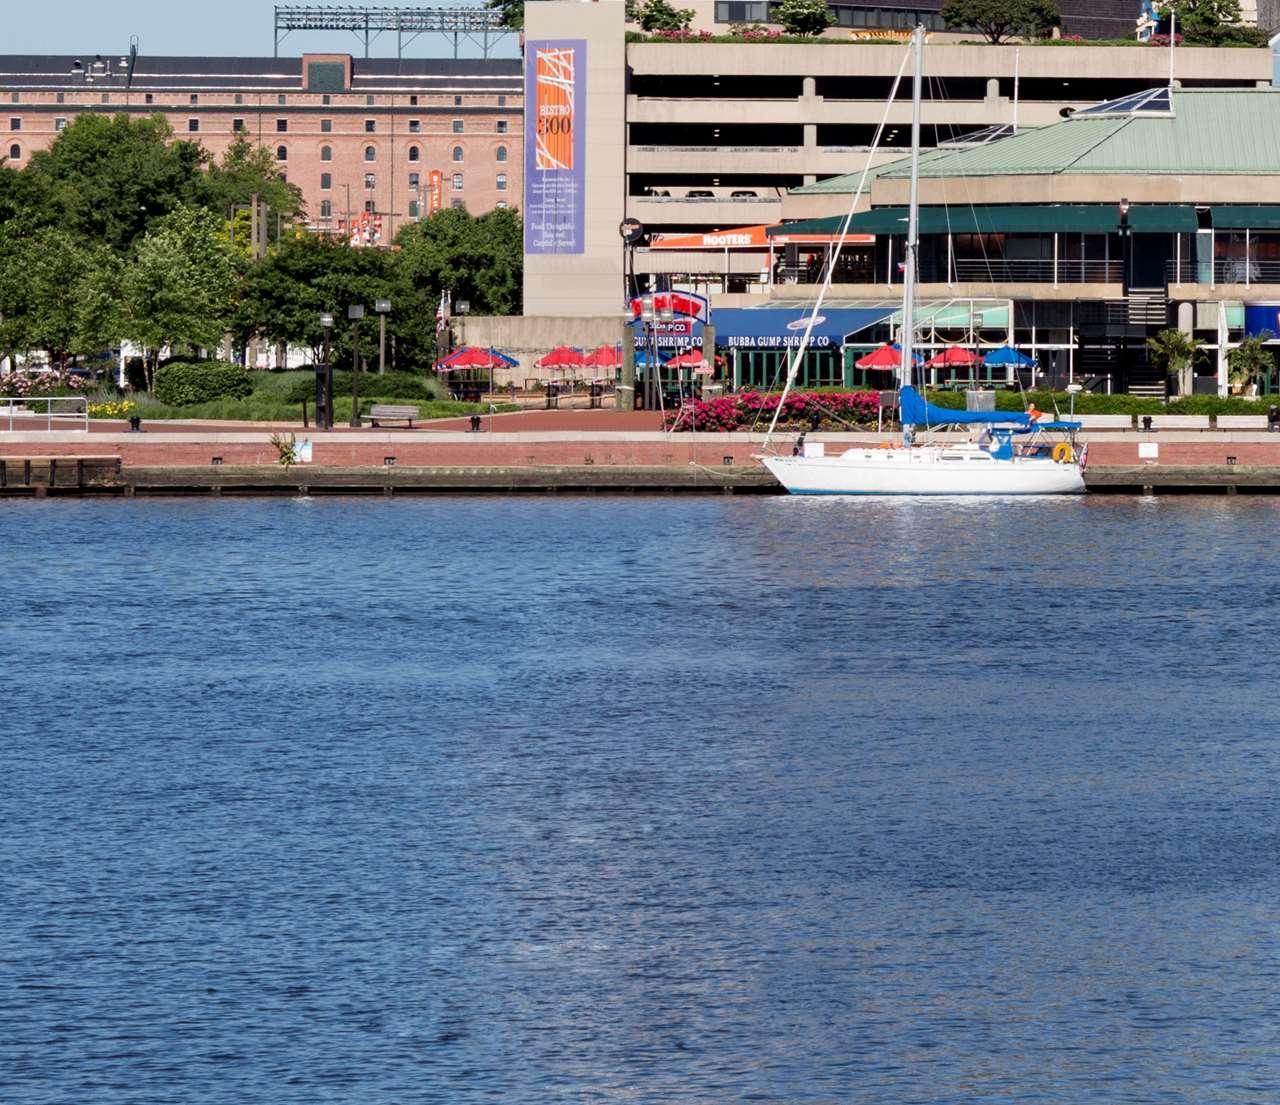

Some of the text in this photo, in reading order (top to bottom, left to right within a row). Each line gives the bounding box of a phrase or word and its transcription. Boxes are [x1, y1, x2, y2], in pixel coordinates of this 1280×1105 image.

[540, 104, 571, 116] BISTRO
[538, 116, 571, 135] 300
[702, 234, 753, 246] HOOTERS
[658, 336, 690, 347] SHRIMP
[691, 336, 703, 347] CO
[728, 336, 829, 347] BUBBA GUMP SHRIP CO
